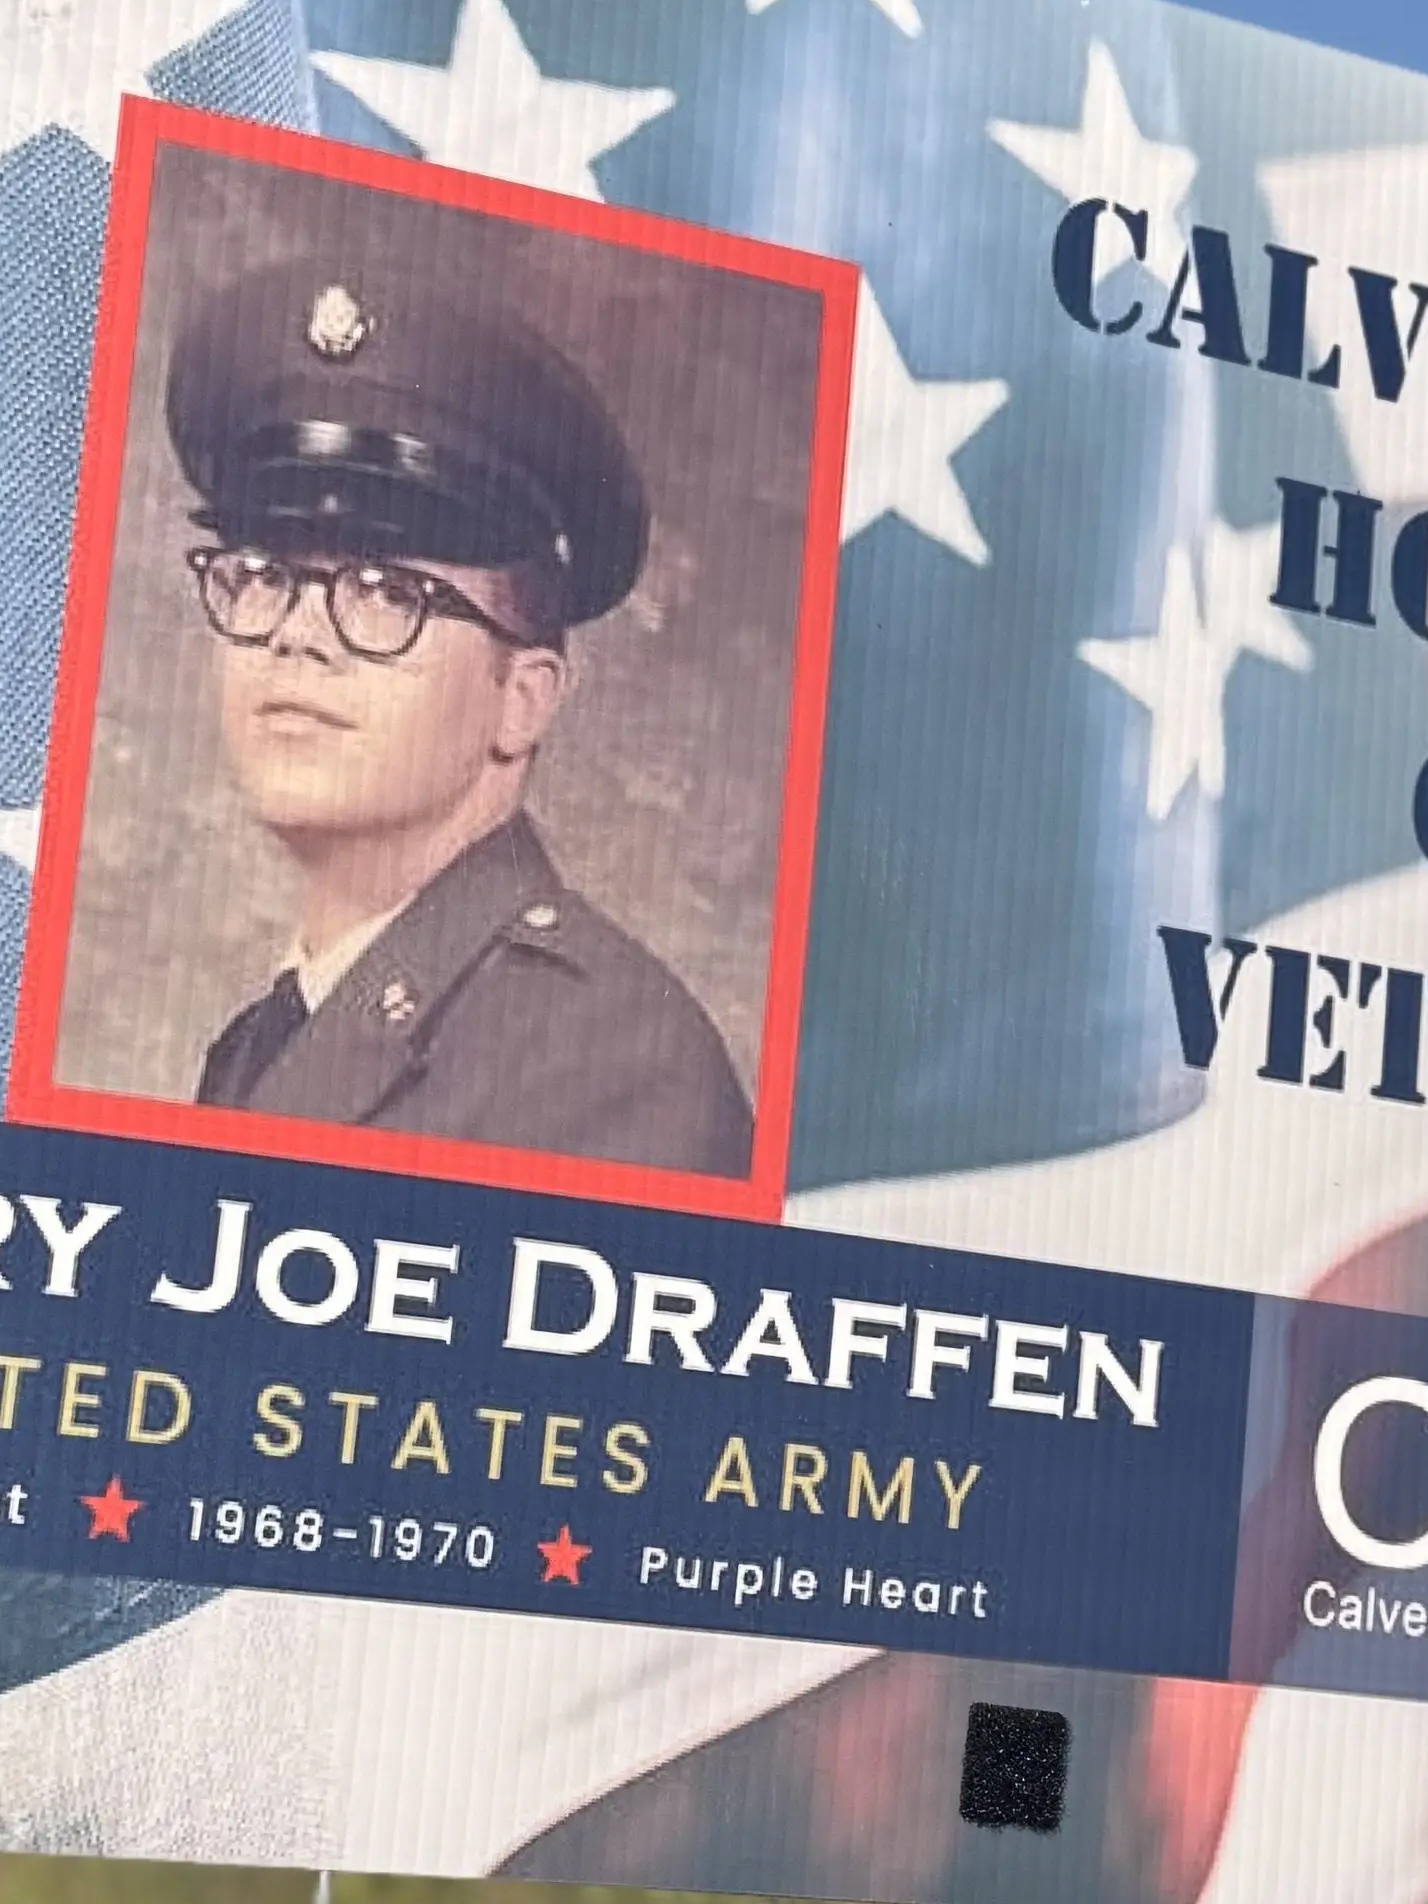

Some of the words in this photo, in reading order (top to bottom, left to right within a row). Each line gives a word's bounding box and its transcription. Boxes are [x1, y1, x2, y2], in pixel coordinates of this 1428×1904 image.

[151, 1199, 459, 1345] JOE
[503, 1237, 1163, 1426] DRAFFEN
[251, 1383, 650, 1494] STATES
[705, 1437, 981, 1530] ARMY
[189, 1500, 494, 1568] 1968-1970
[640, 1546, 817, 1606] Purple
[843, 1567, 987, 1618] Heart
